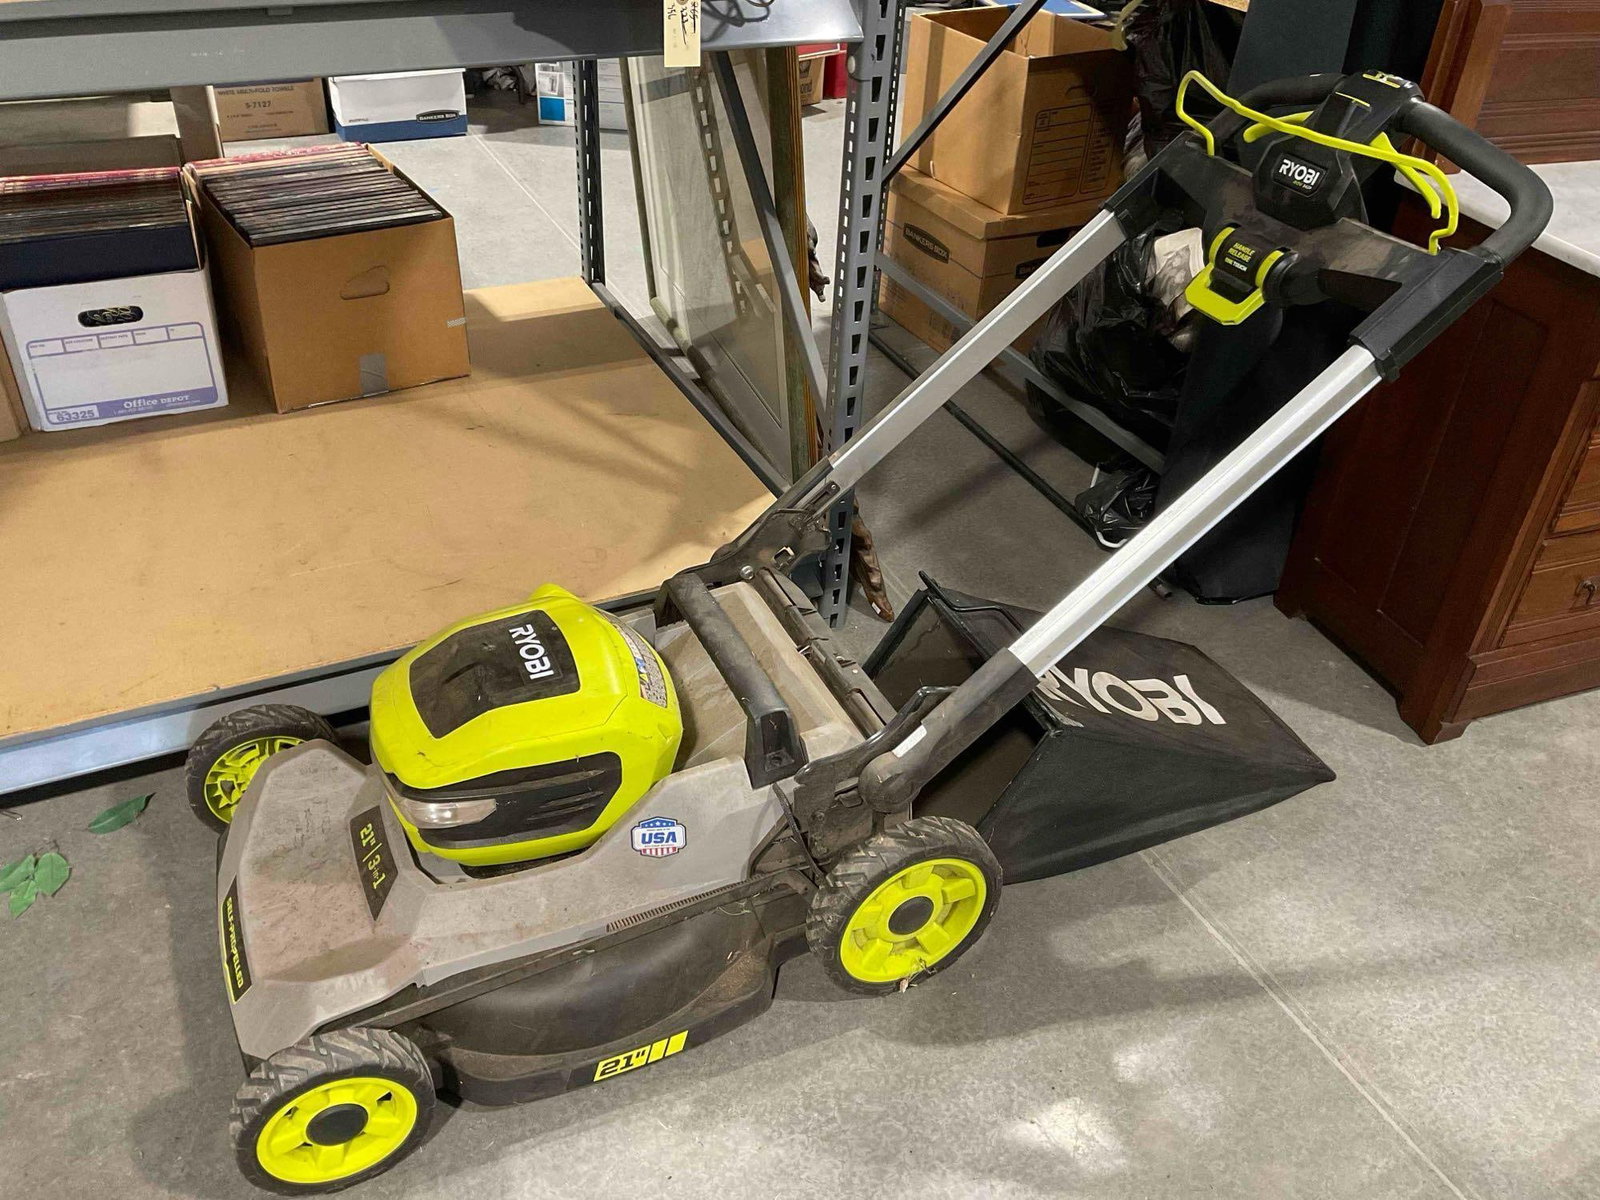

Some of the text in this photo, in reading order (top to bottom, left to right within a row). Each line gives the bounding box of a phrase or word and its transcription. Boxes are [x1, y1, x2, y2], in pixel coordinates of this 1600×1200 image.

[1279, 158, 1320, 186] RYOBI
[905, 227, 948, 259] BANKERS BOX
[1233, 242, 1255, 256] HANDLE
[1228, 247, 1251, 262] RELEASE
[123, 398, 158, 409] Office
[160, 394, 190, 404] DEPOT
[56, 409, 95, 421] 63325
[508, 624, 554, 680] RYOBI
[641, 831, 677, 844] USA
[226, 896, 244, 989] SELF-PROPELLED
[599, 1049, 646, 1077] 21"
